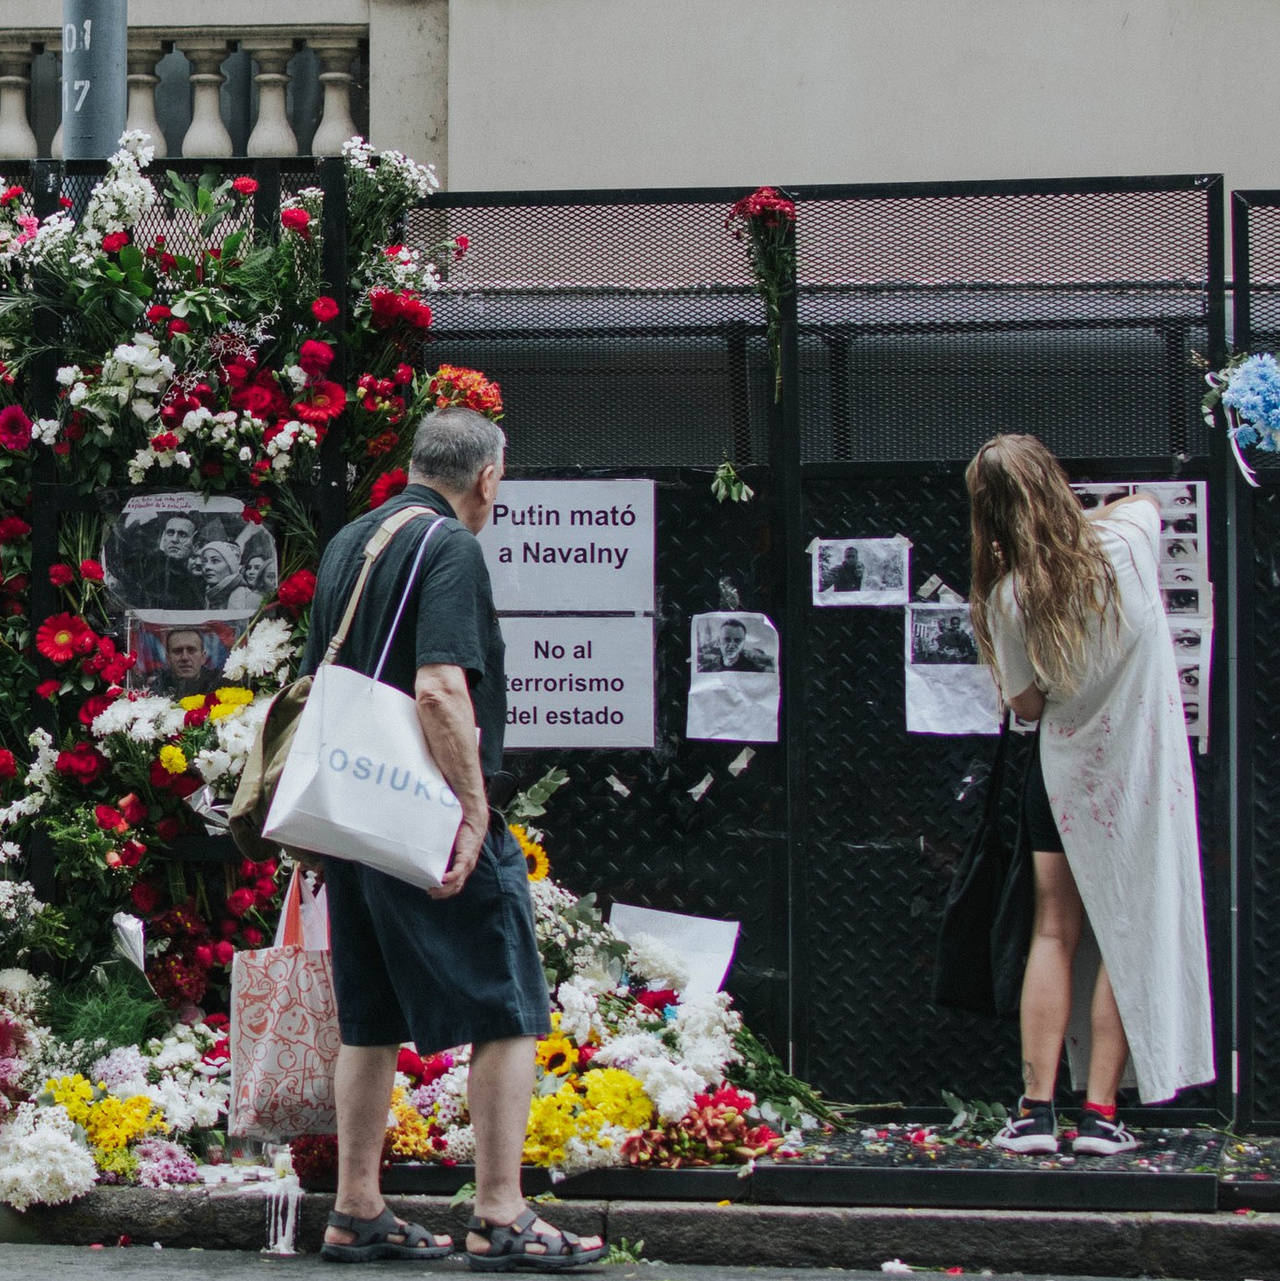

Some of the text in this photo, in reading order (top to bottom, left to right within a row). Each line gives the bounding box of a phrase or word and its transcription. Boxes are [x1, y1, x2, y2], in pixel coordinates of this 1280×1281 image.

[492, 503, 637, 526] Putin mató
[498, 542, 629, 570] a Navalny
[533, 640, 593, 659] No al
[505, 673, 625, 692] terrorismo
[506, 706, 625, 725] del estado
[320, 743, 457, 808] OSIUKO
